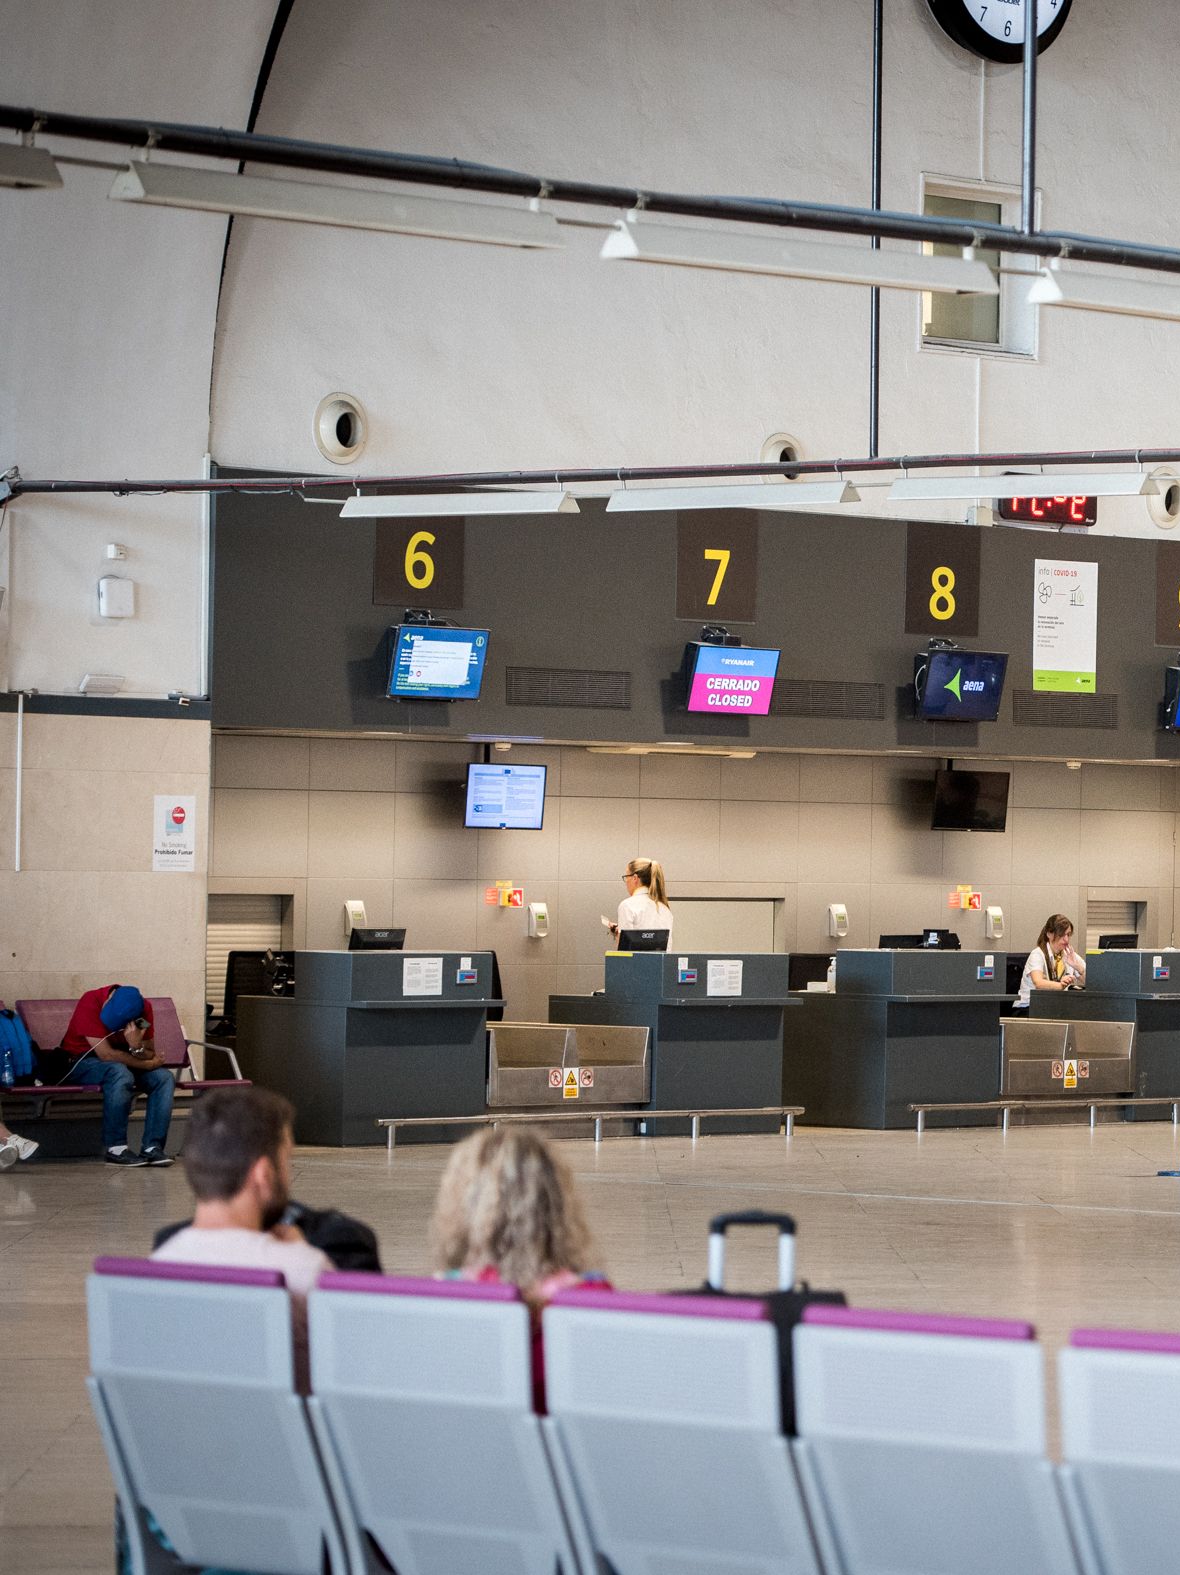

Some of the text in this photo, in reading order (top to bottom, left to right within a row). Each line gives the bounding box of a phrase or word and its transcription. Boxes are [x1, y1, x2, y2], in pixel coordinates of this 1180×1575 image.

[980, 5, 988, 22] 7
[1004, 20, 1012, 37] 6
[405, 531, 435, 589] 6
[704, 549, 731, 605] 7
[1038, 567, 1078, 577] info COVID-19
[929, 566, 956, 621] 8
[725, 658, 755, 667] RYANAIR
[706, 677, 760, 692] CERRADO
[963, 680, 985, 692] aena
[707, 693, 753, 707] CLOSED
